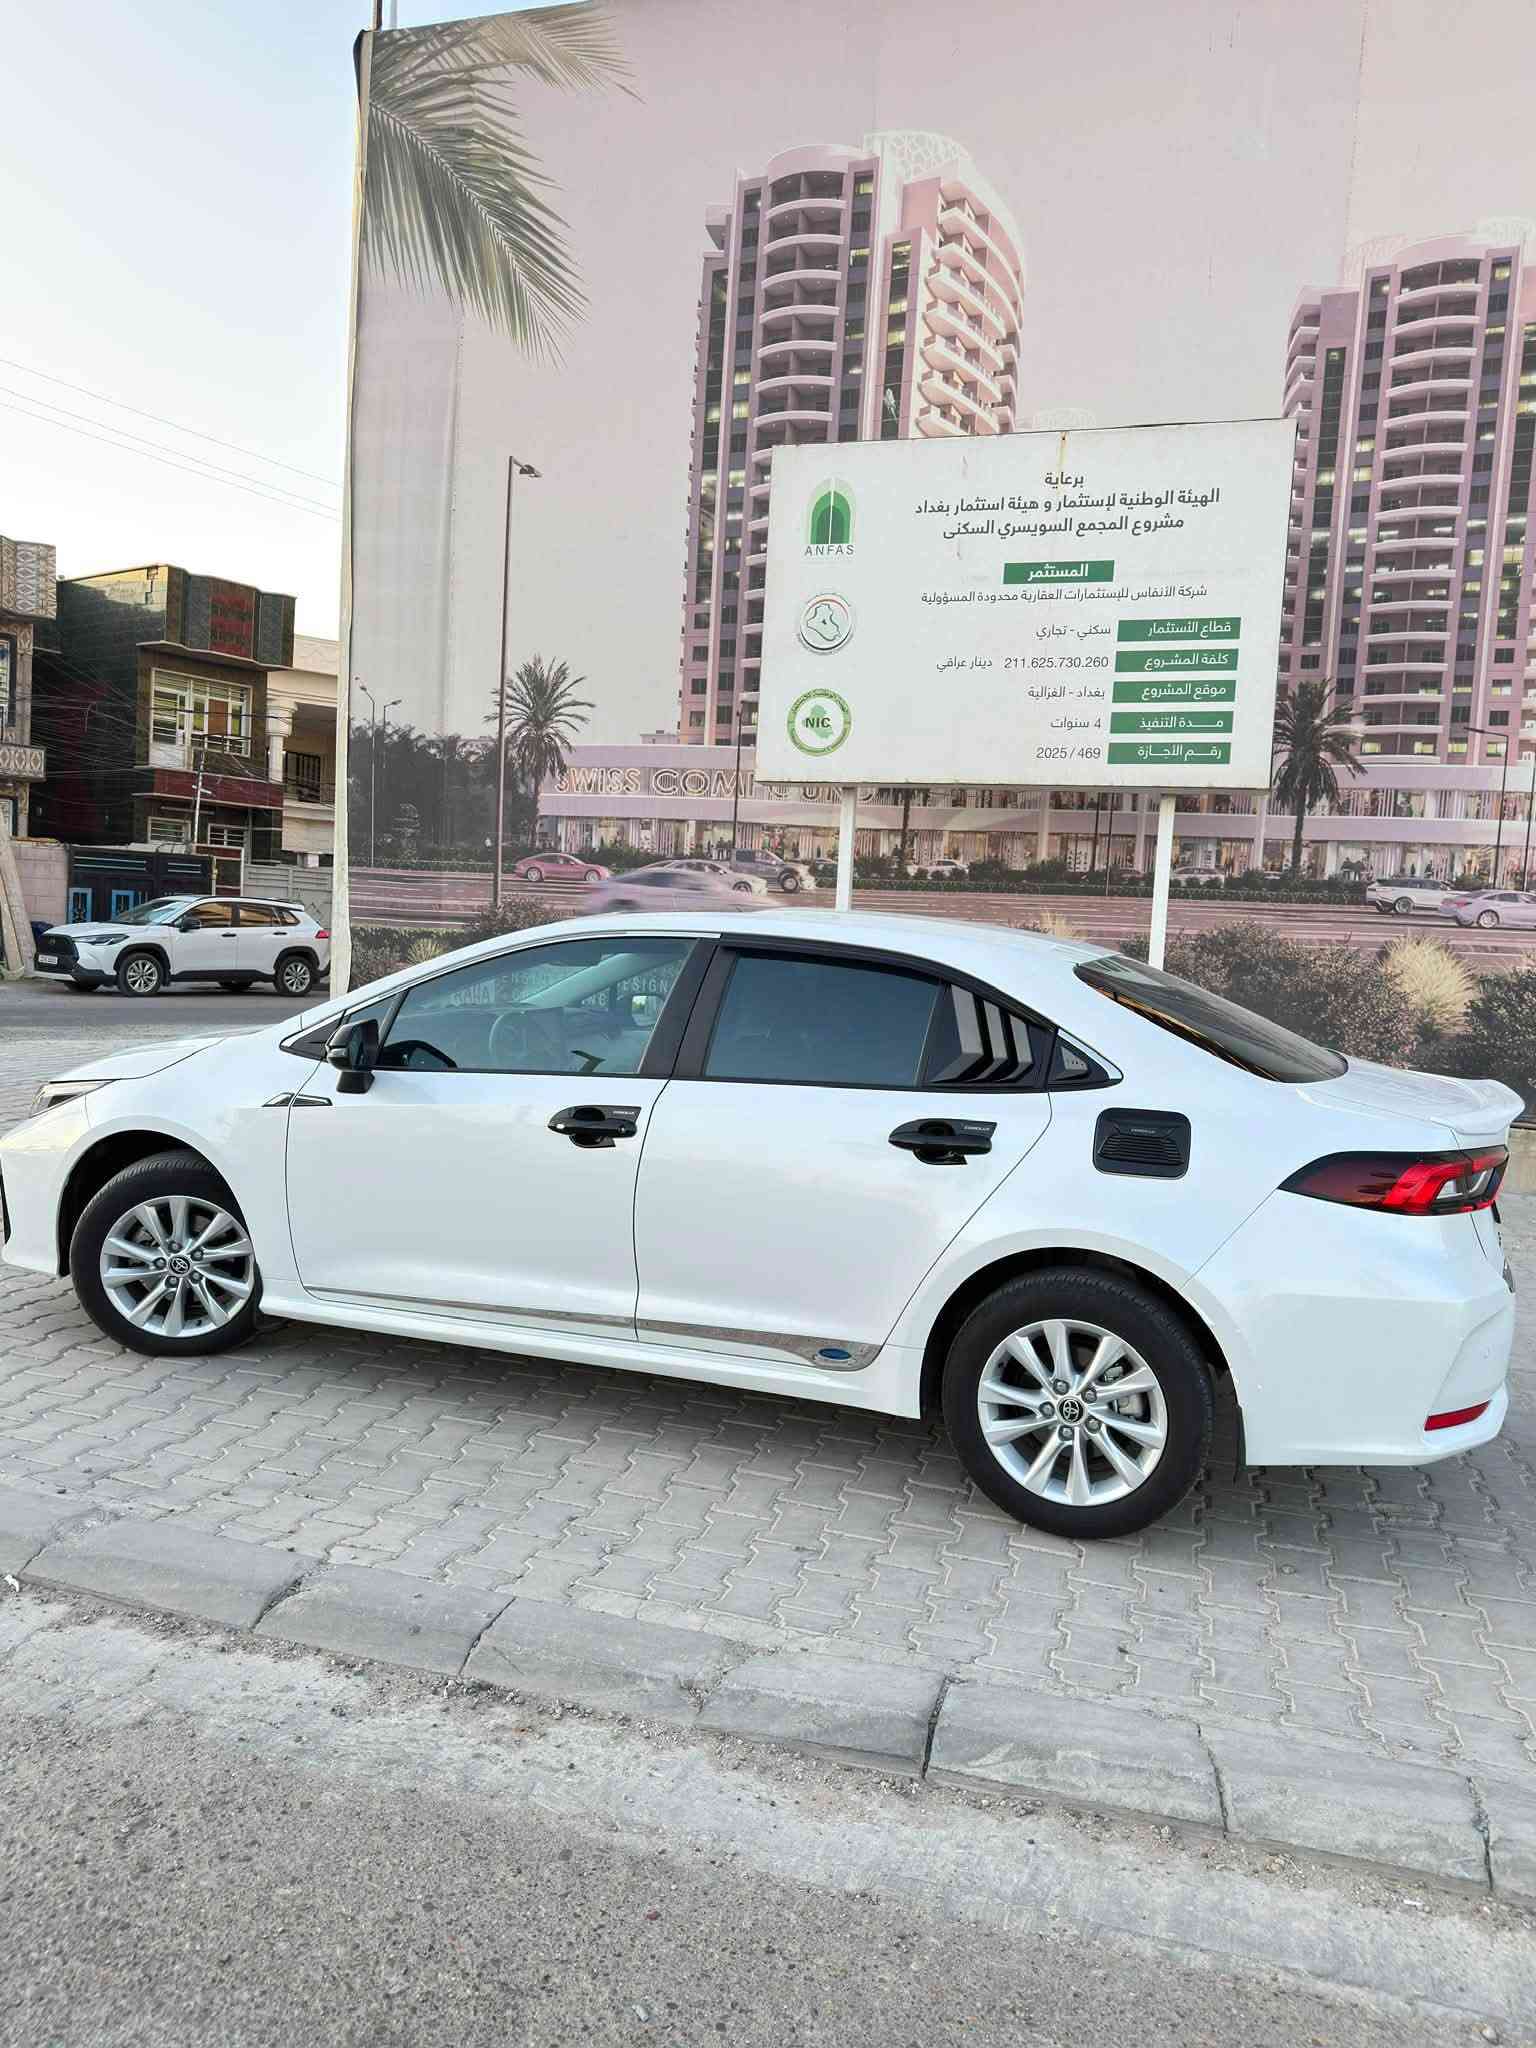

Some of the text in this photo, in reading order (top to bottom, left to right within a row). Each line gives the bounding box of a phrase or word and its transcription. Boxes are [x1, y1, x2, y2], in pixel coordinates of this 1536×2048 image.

[1044, 472, 1084, 489] برعاية
[953, 497, 1004, 516] استثمار
[1008, 496, 1039, 514] هيئة
[1044, 499, 1052, 512] و
[1119, 490, 1174, 510] الوطنية
[1177, 488, 1220, 508] الهيئة
[915, 500, 950, 517] بغداد
[998, 518, 1073, 540] السويسري
[1075, 516, 1128, 537] المجمع
[1131, 513, 1184, 536] مشروع
[804, 544, 855, 557] ANFAS
[1027, 563, 1089, 582] المستثمر
[921, 592, 976, 605] المسؤولية
[977, 592, 1018, 604] محدودة
[1020, 589, 1063, 604] العقارية
[1178, 584, 1208, 599] شركة
[1036, 624, 1068, 641] تجاري
[1076, 624, 1111, 641] سكني
[1200, 620, 1231, 638] قطاع
[936, 655, 1109, 673] 211.625.730.260 دينار عراقي
[1200, 652, 1229, 665] كلفة
[1027, 685, 1066, 701] الغزالية
[1076, 685, 1105, 701] بغداد
[1141, 683, 1227, 701] موقع المشروع
[805, 717, 832, 729] NIC
[1050, 717, 1101, 731] 4 سنوات
[1139, 715, 1177, 731] التنفيذ
[1036, 747, 1067, 760] 2025
[1077, 747, 1101, 760] 469
[555, 767, 641, 793] SWISS
